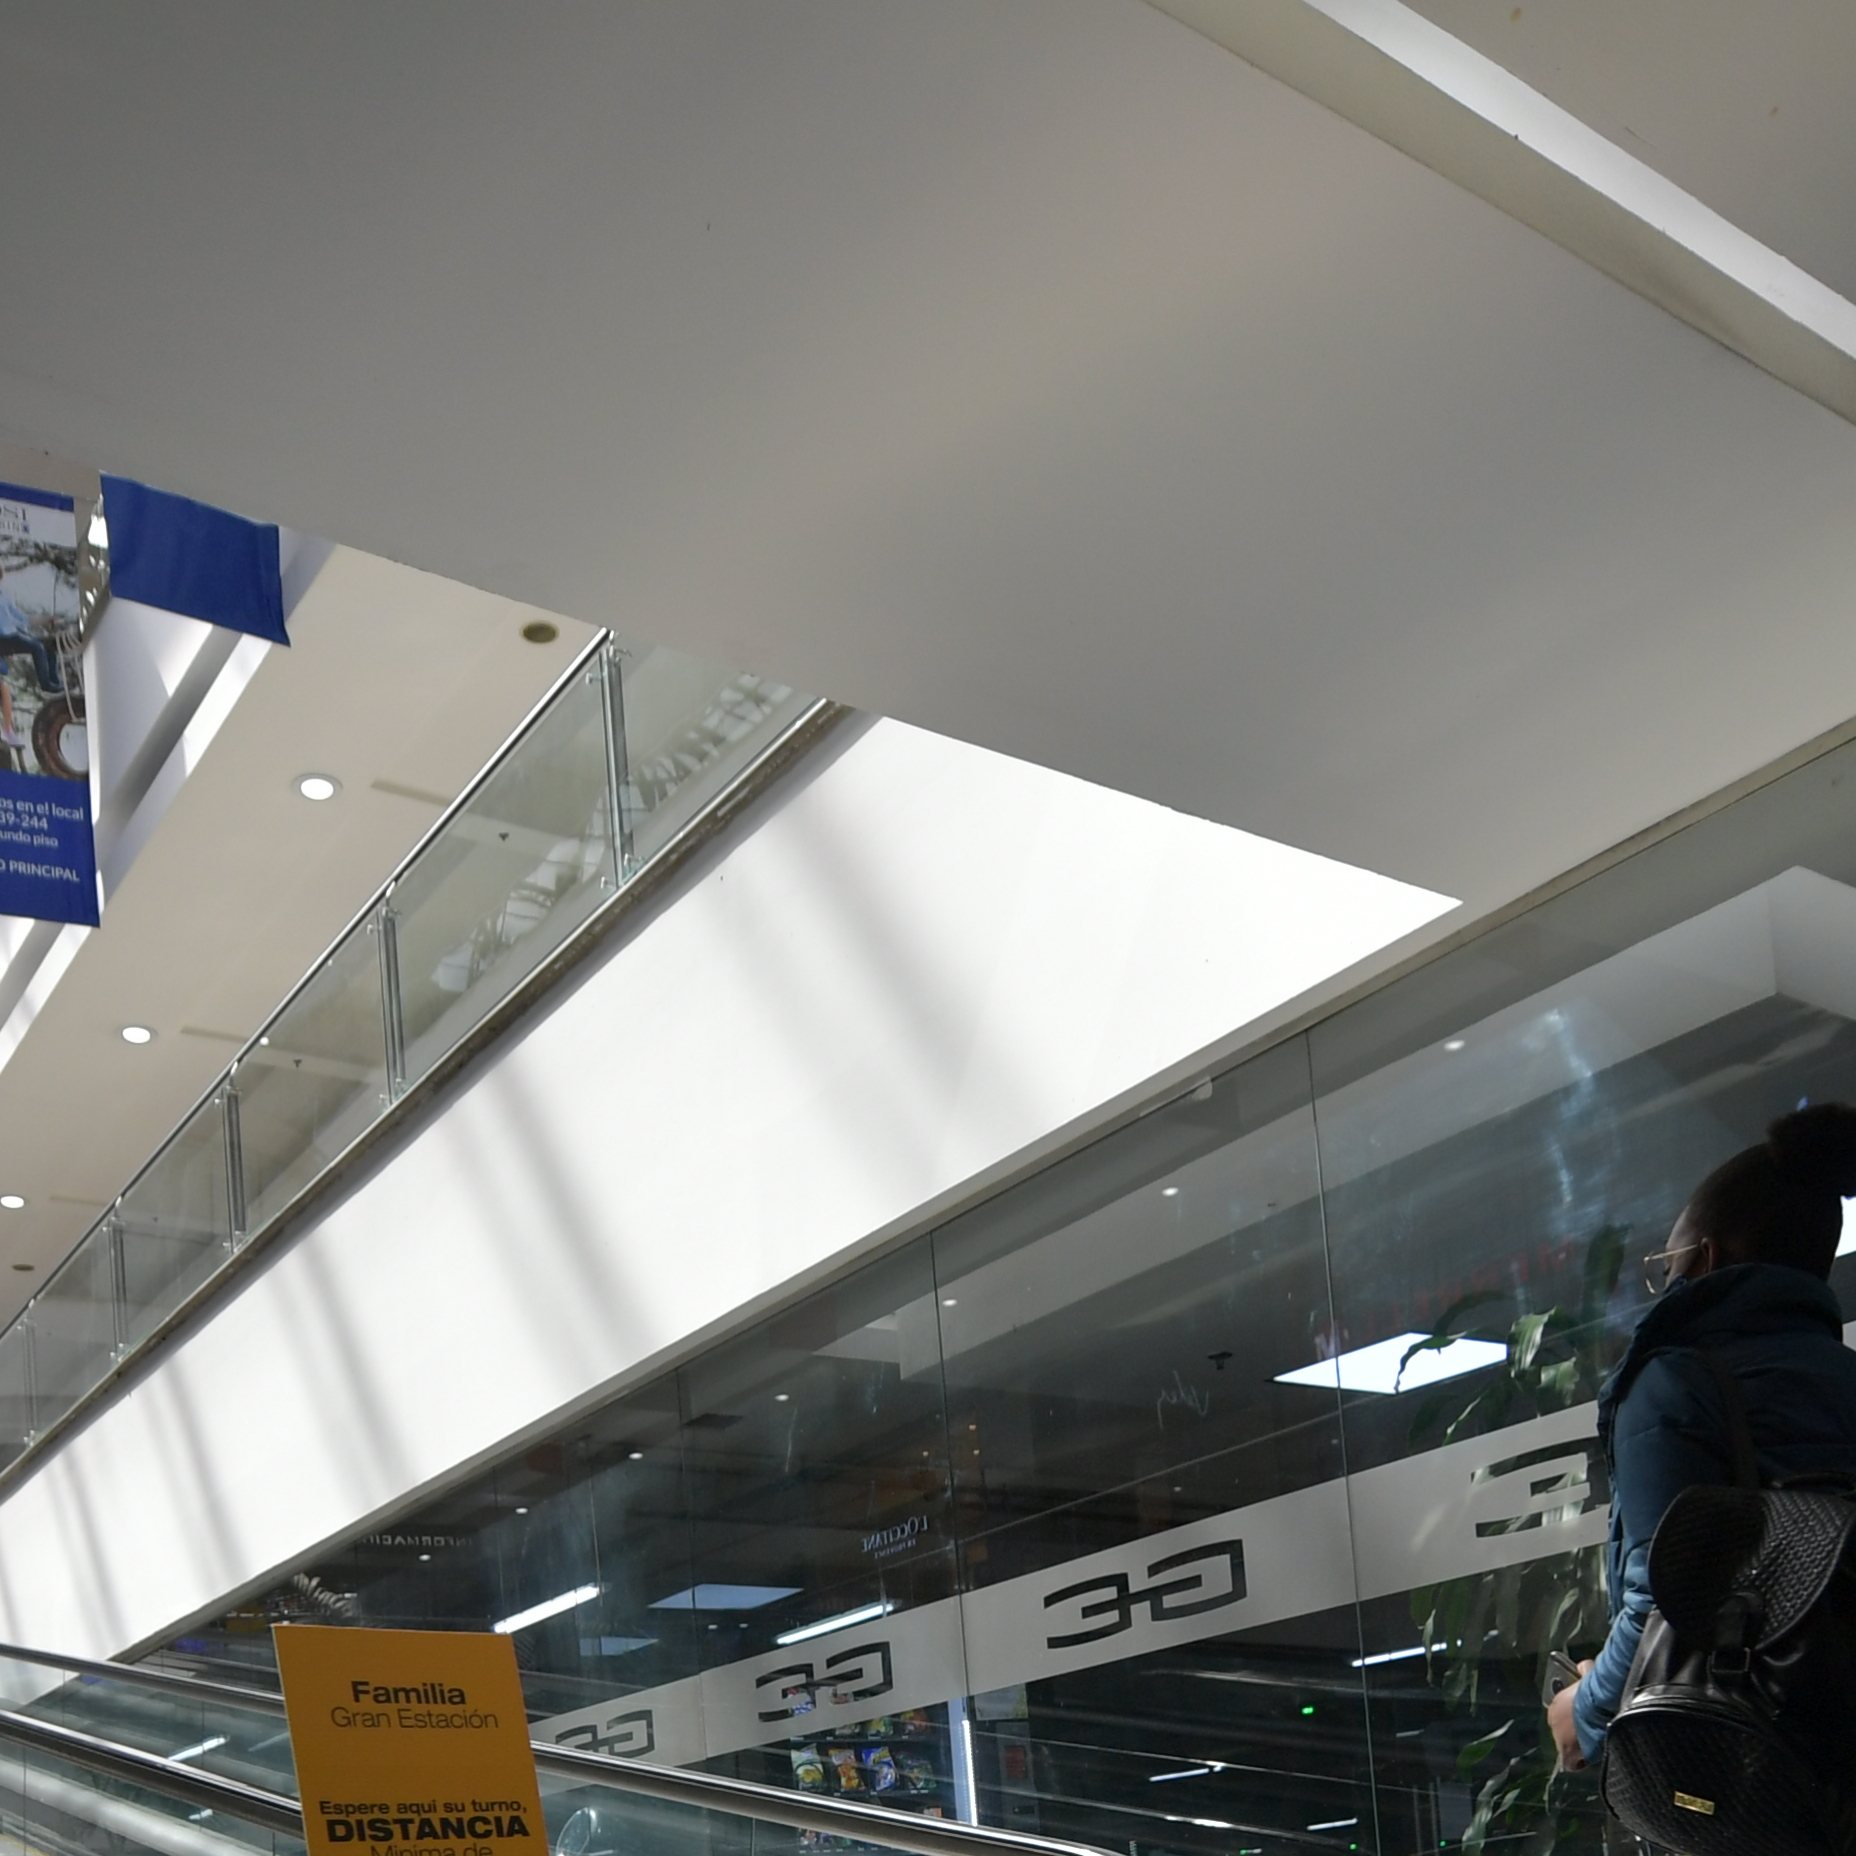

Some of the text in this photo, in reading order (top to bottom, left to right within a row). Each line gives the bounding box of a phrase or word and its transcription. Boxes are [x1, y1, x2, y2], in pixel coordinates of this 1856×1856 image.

[16, 799, 35, 814] en
[37, 797, 50, 816] el
[51, 799, 85, 821] local
[33, 831, 59, 848] piso
[9, 860, 80, 883] PRINCIPAL
[351, 1680, 467, 1706] Familia
[331, 1706, 499, 1730] Gran Estación
[319, 1800, 390, 1816] Espere
[443, 1800, 466, 1814] su
[471, 1799, 528, 1814] turno,
[326, 1815, 530, 1843] DISTANCIA
